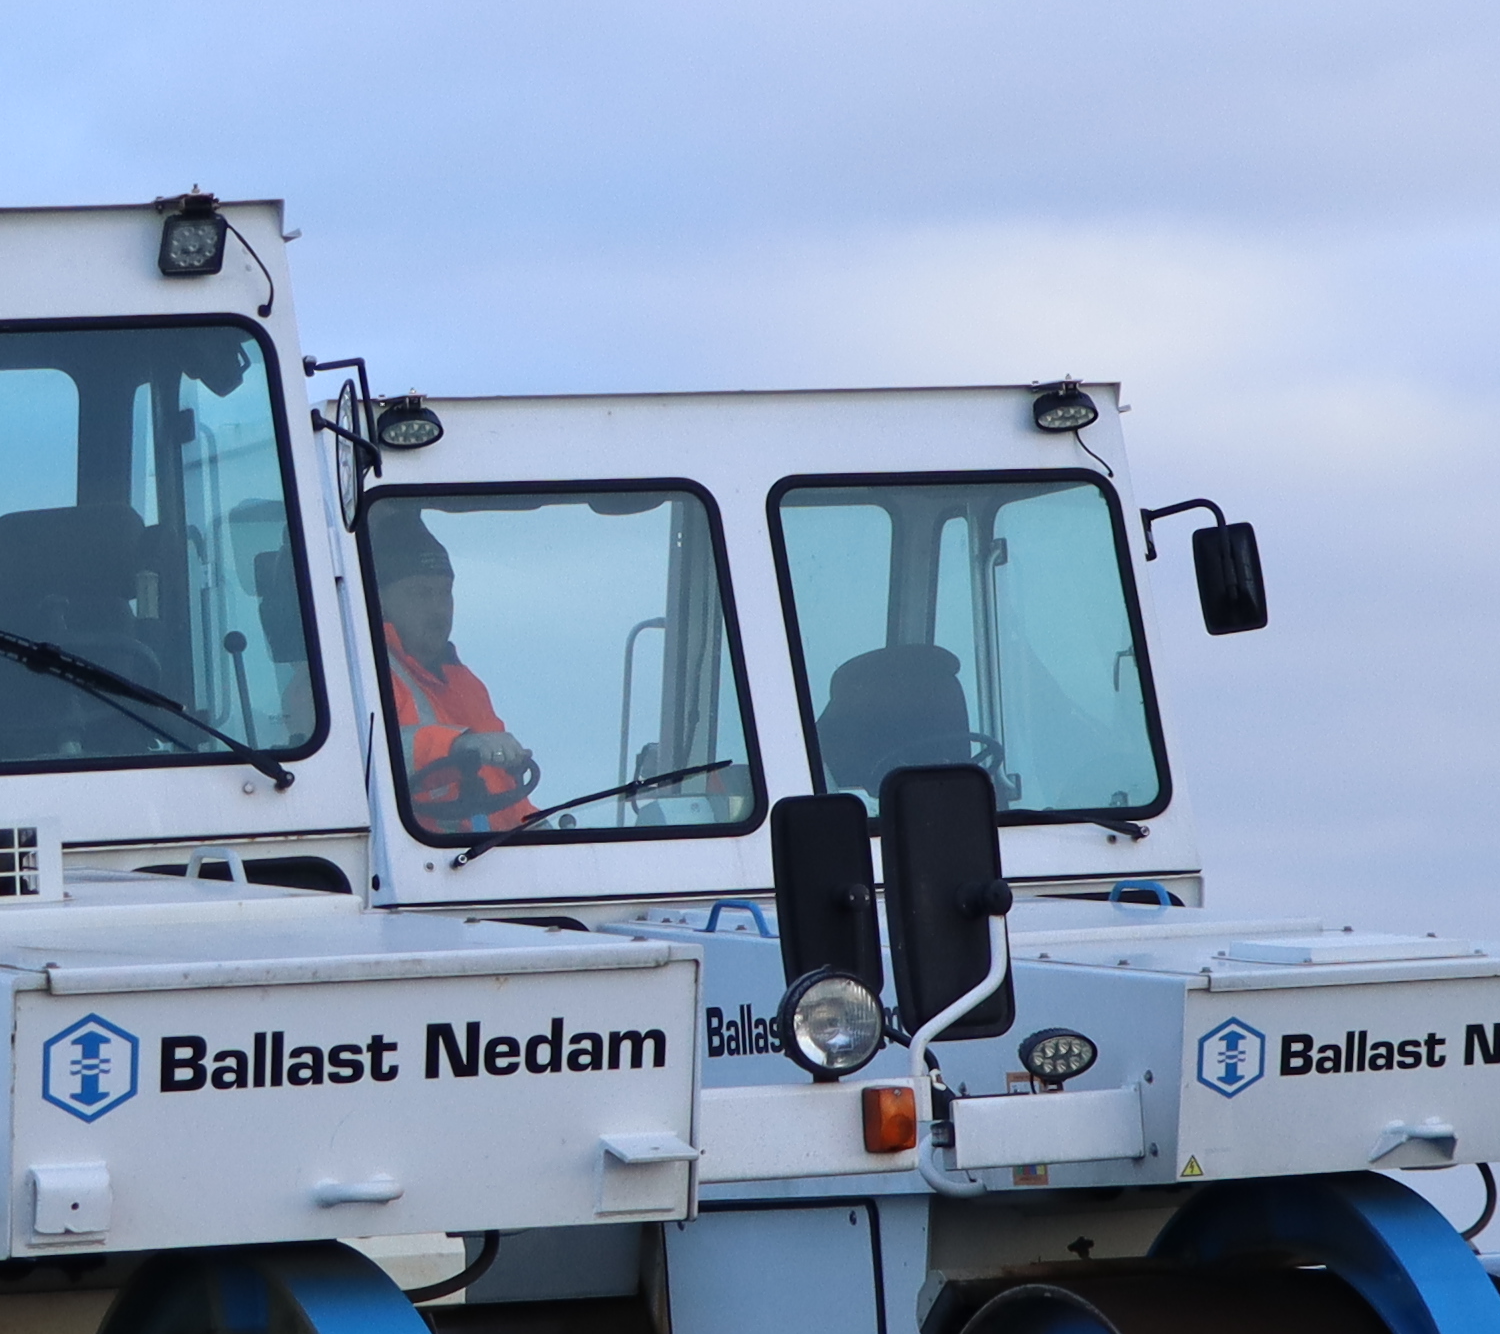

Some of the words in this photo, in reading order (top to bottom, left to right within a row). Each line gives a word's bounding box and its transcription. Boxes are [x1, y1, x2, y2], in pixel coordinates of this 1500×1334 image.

[160, 1030, 399, 1093] Ballast
[424, 1017, 667, 1079] Nedam
[706, 1003, 785, 1058] Ballas
[1279, 1030, 1446, 1077] Ballast
